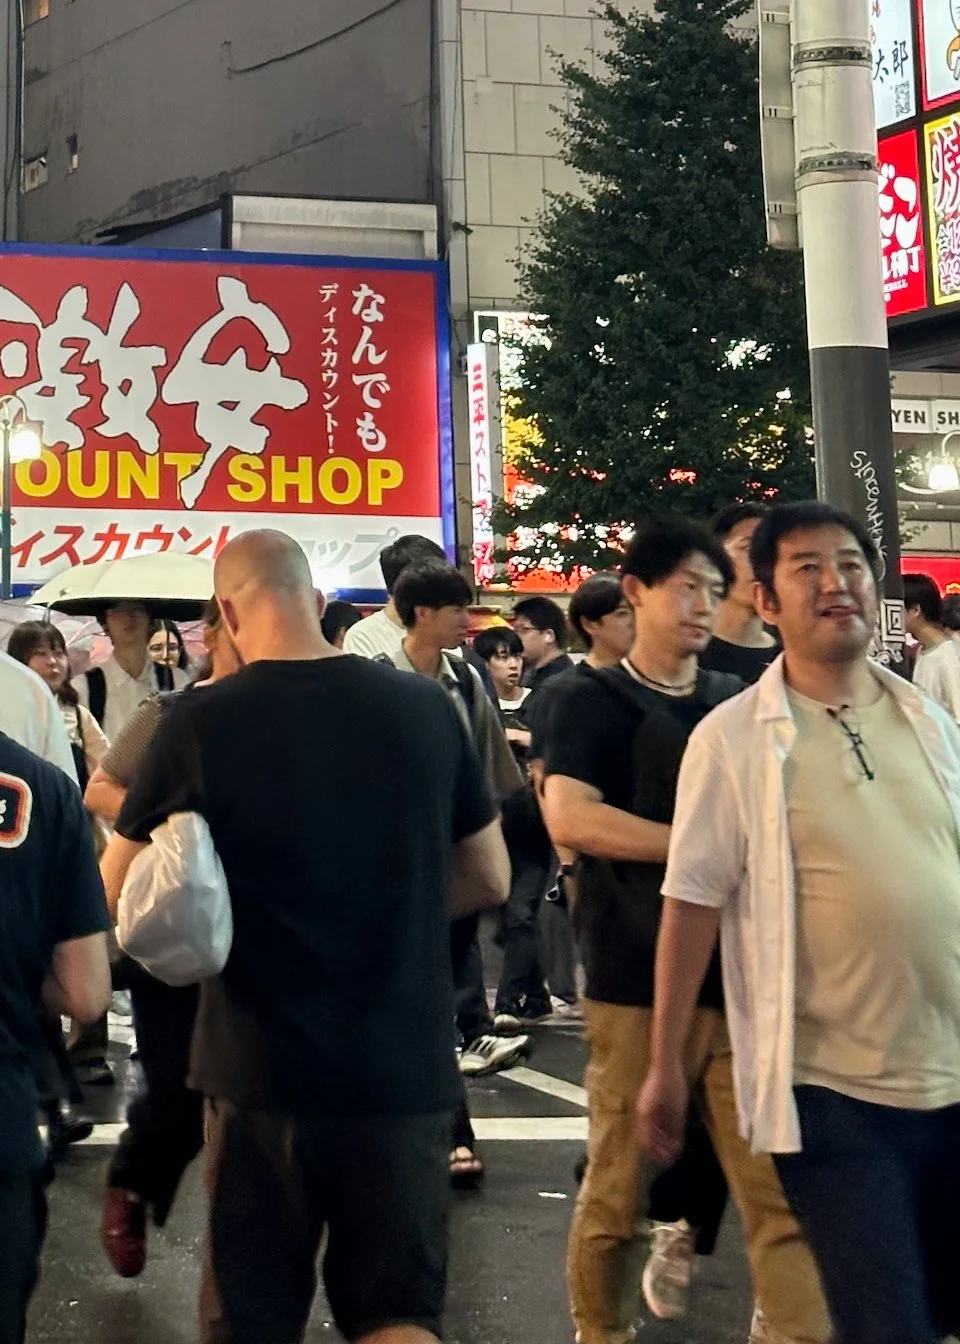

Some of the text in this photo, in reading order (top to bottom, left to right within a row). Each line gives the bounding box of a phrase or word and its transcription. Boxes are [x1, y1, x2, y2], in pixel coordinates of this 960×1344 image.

[351, 283, 391, 452] なんでも
[891, 409, 926, 424] YEN
[226, 455, 404, 506] SHOP
